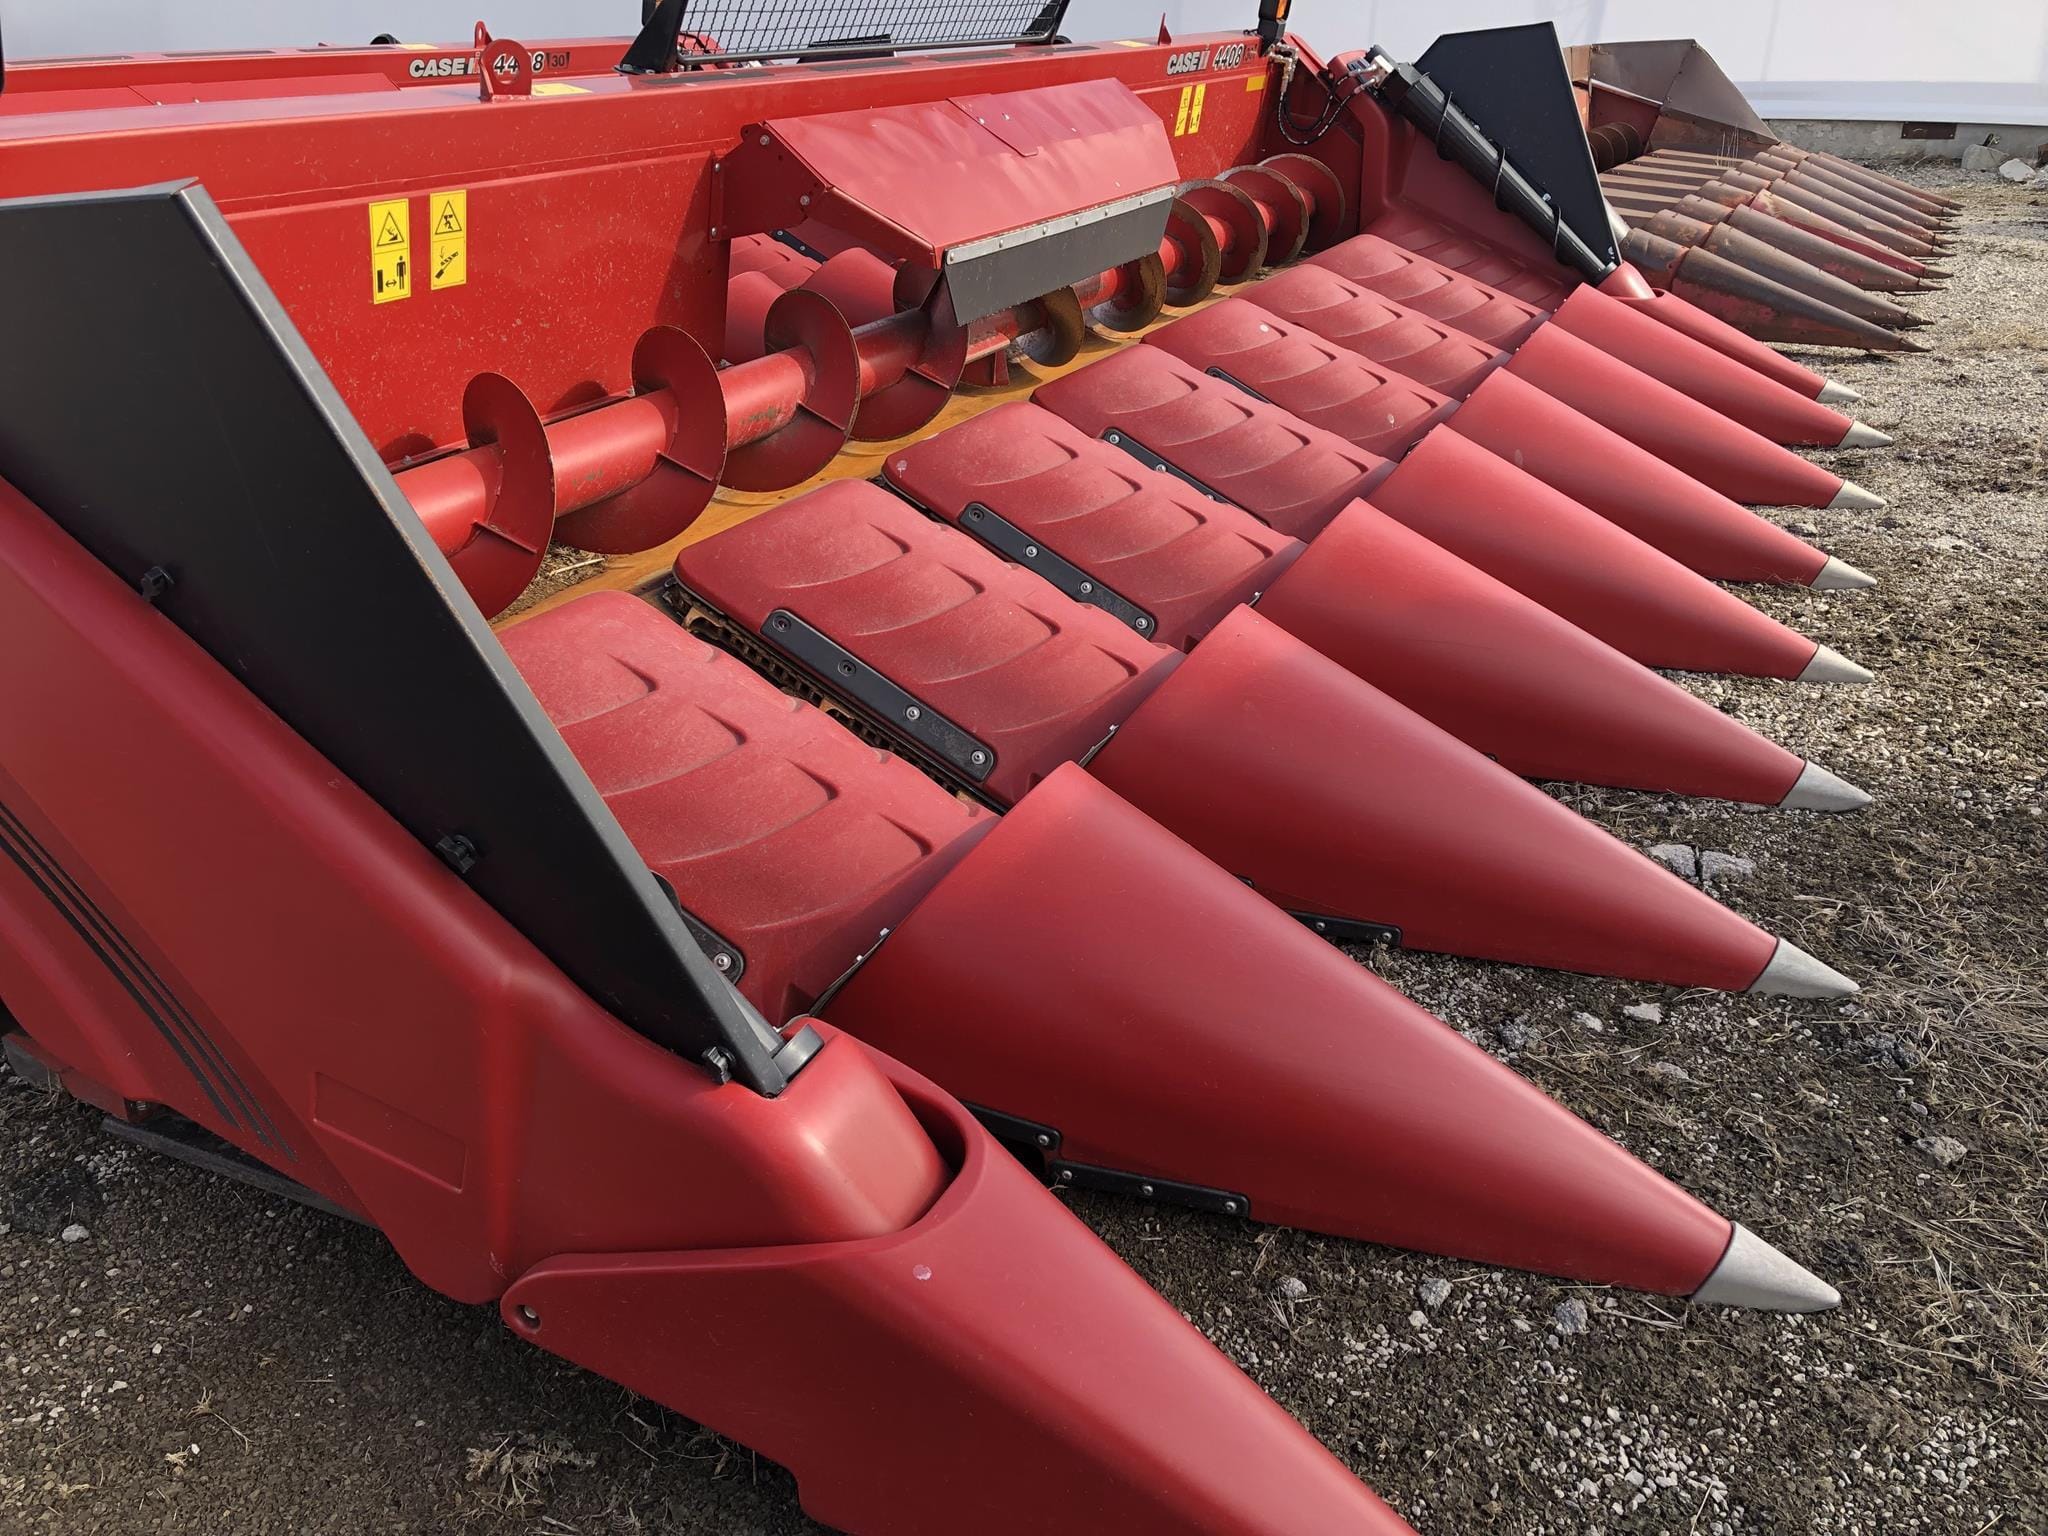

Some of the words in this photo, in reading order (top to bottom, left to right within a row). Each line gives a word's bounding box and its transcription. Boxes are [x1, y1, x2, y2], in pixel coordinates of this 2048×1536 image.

[409, 57, 466, 78] CASE
[1167, 51, 1200, 75] CASE
[1212, 43, 1245, 72] 4408
